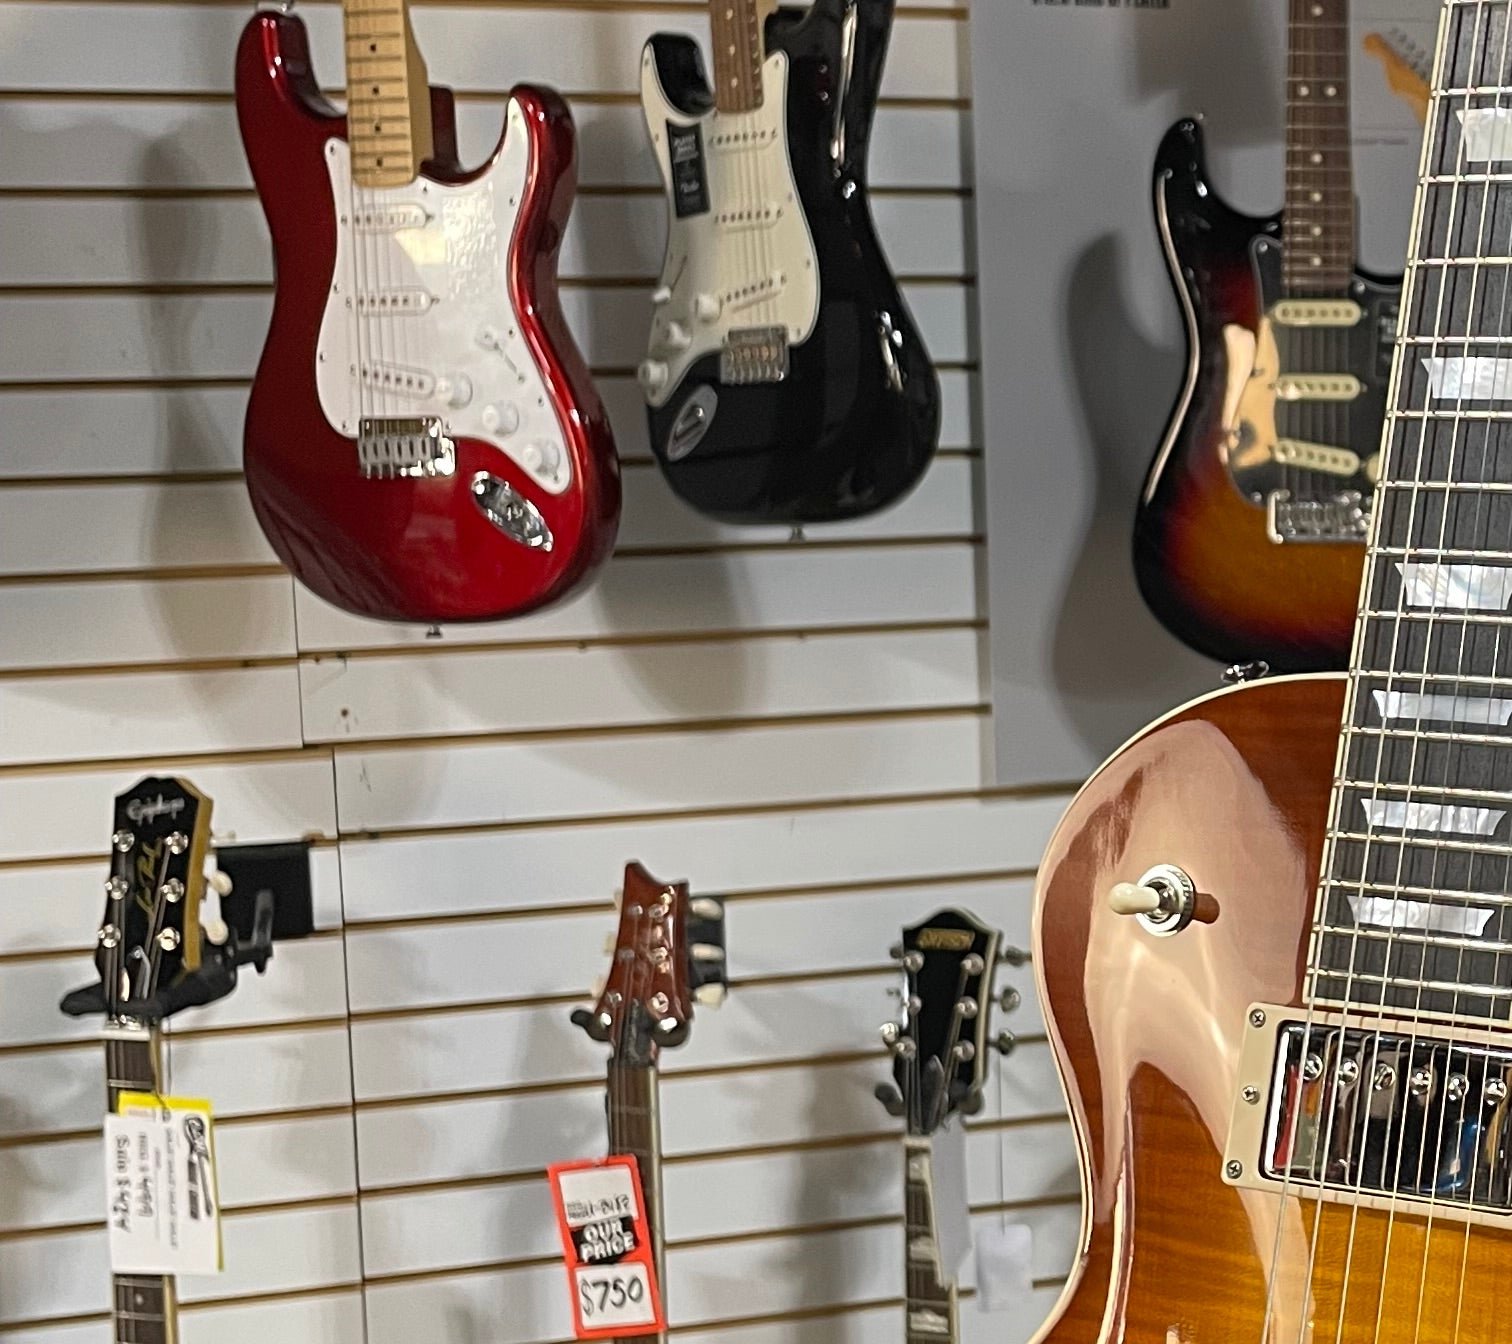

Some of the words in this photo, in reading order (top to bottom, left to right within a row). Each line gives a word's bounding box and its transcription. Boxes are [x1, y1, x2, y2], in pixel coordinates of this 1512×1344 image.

[579, 1230, 636, 1264] PRICE
[583, 1217, 624, 1244] OUR
[580, 1275, 645, 1318] $750
